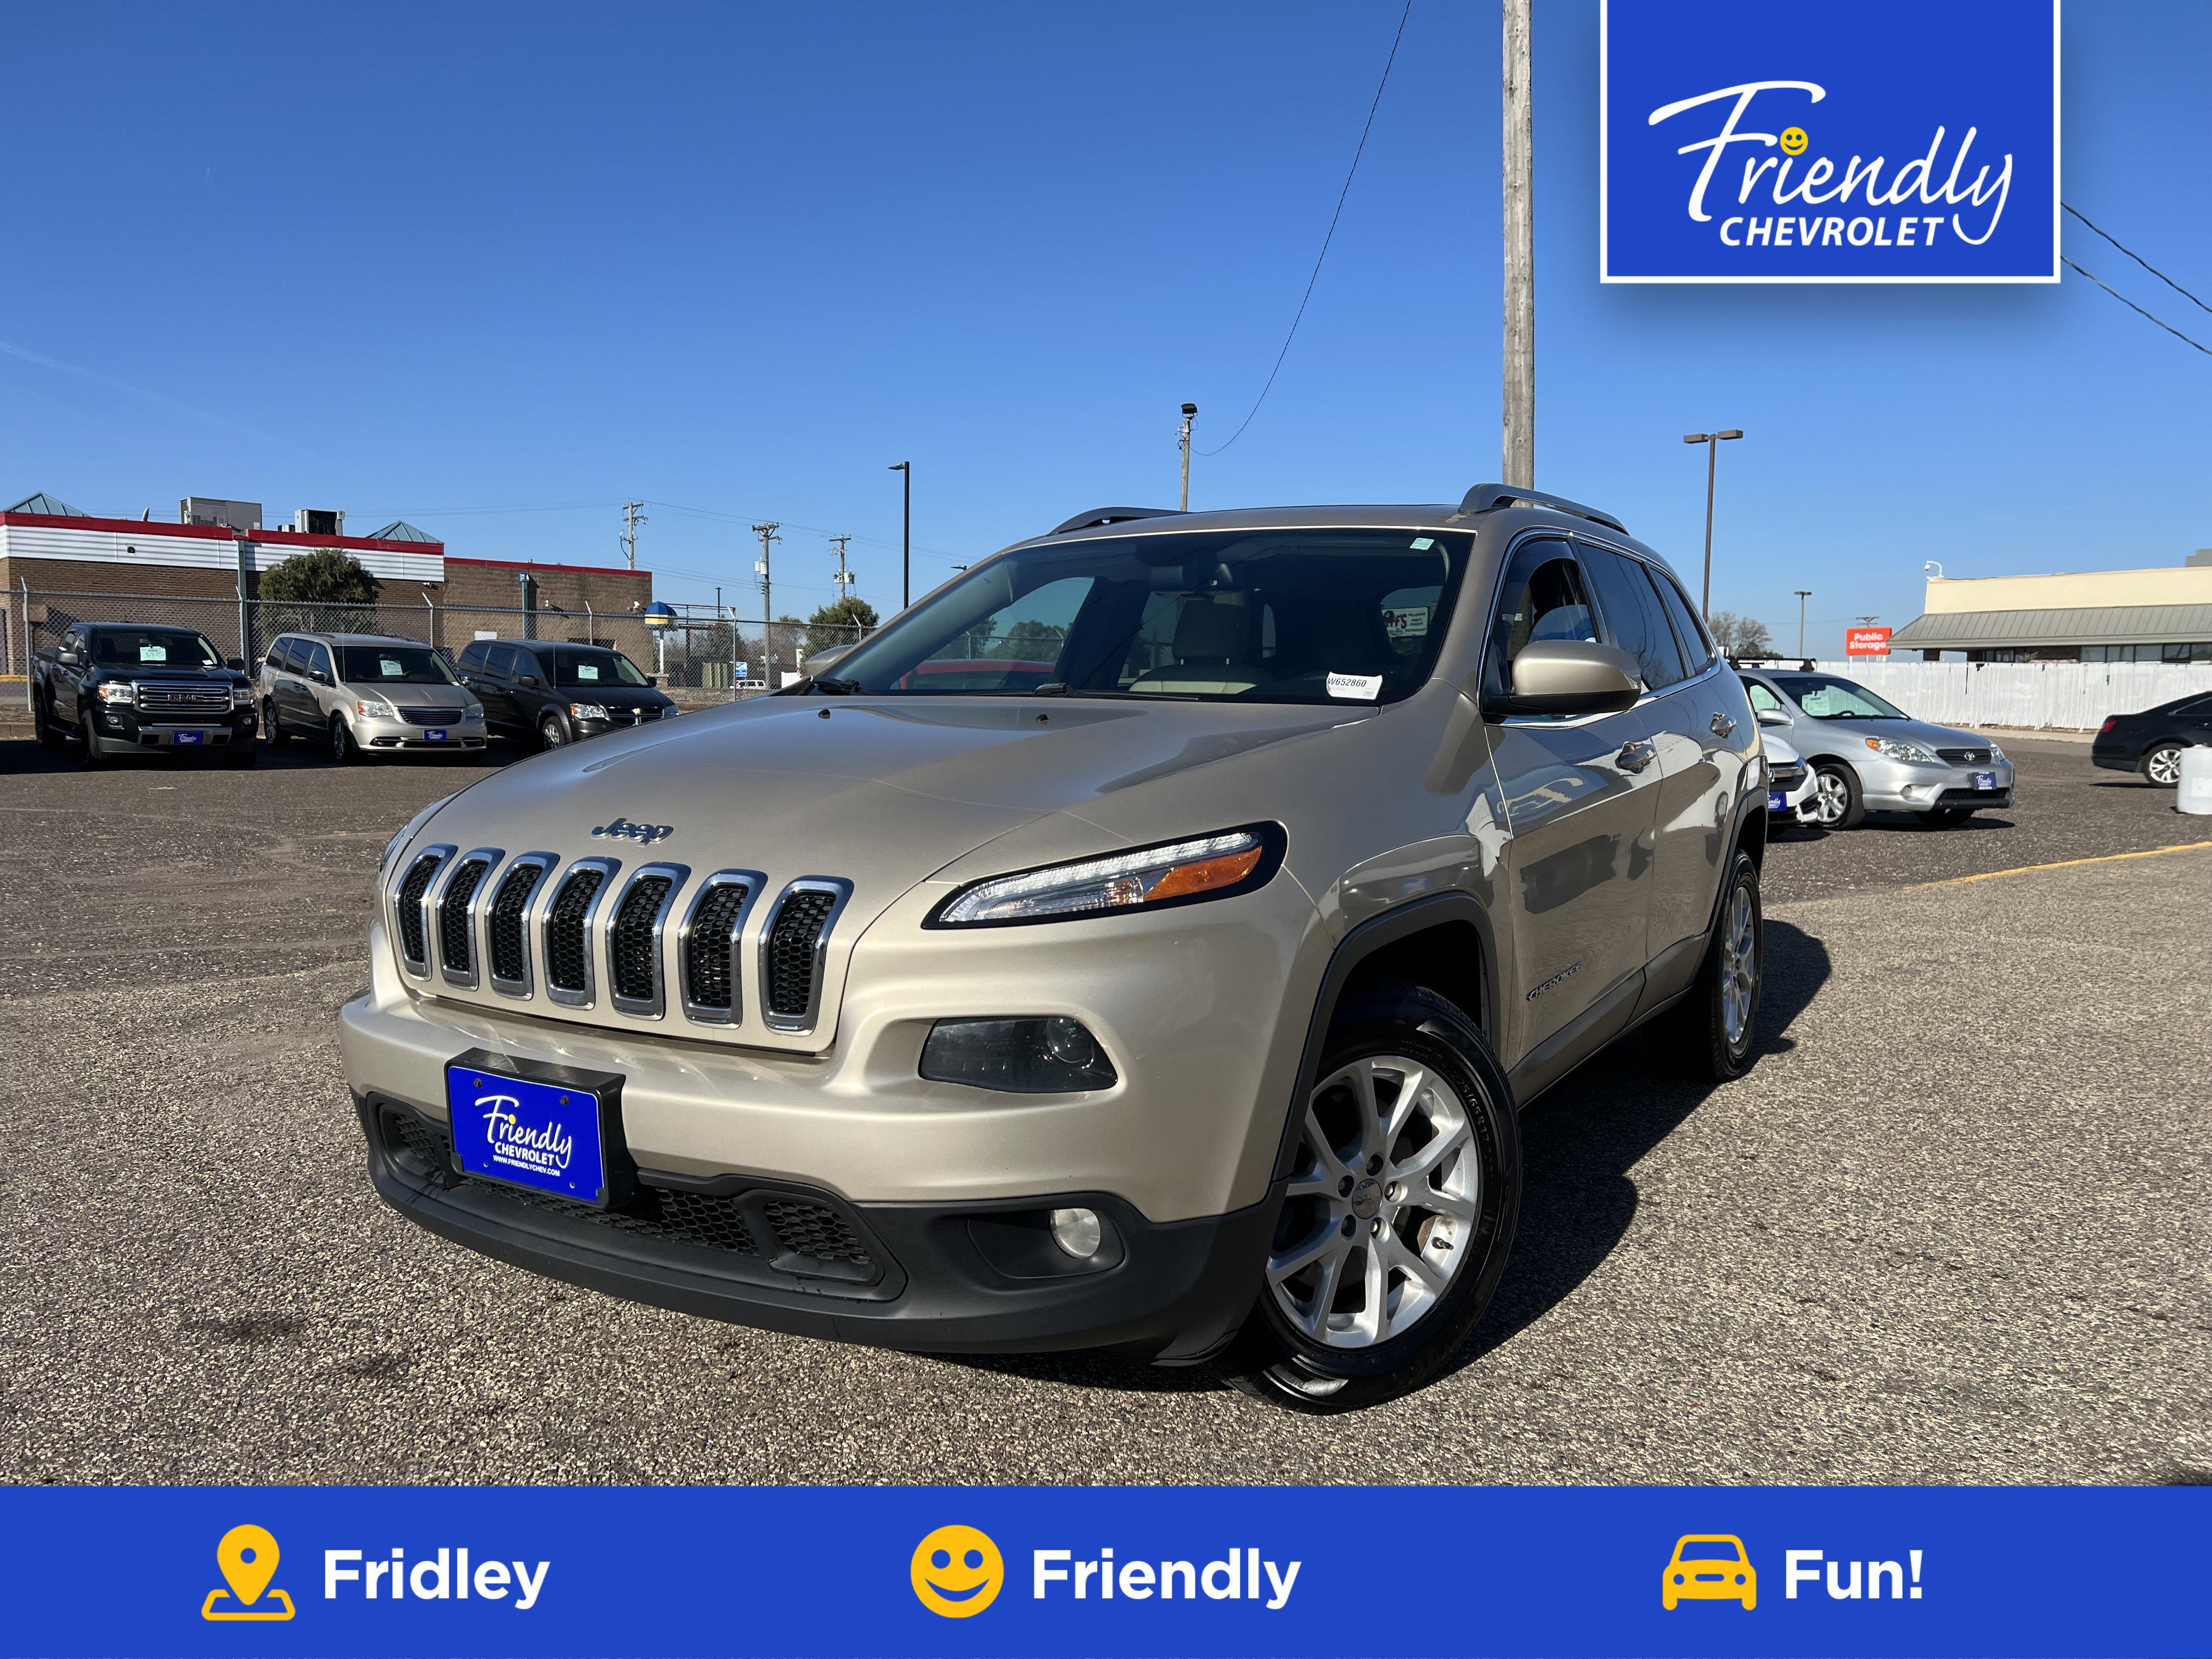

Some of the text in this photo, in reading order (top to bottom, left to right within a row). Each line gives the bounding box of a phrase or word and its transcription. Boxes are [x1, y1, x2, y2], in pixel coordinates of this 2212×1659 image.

[1849, 640, 1886, 651] Storage
[1854, 632, 1883, 641] Public
[1328, 678, 1367, 687] W652860
[591, 817, 674, 846] Jeep
[1526, 961, 1582, 1001] CHEROKEE
[475, 1095, 572, 1169] Friendly
[493, 1154, 561, 1177] WWW.FRIENDLYCHEV.COM
[494, 1141, 555, 1166] CHEVROLET
